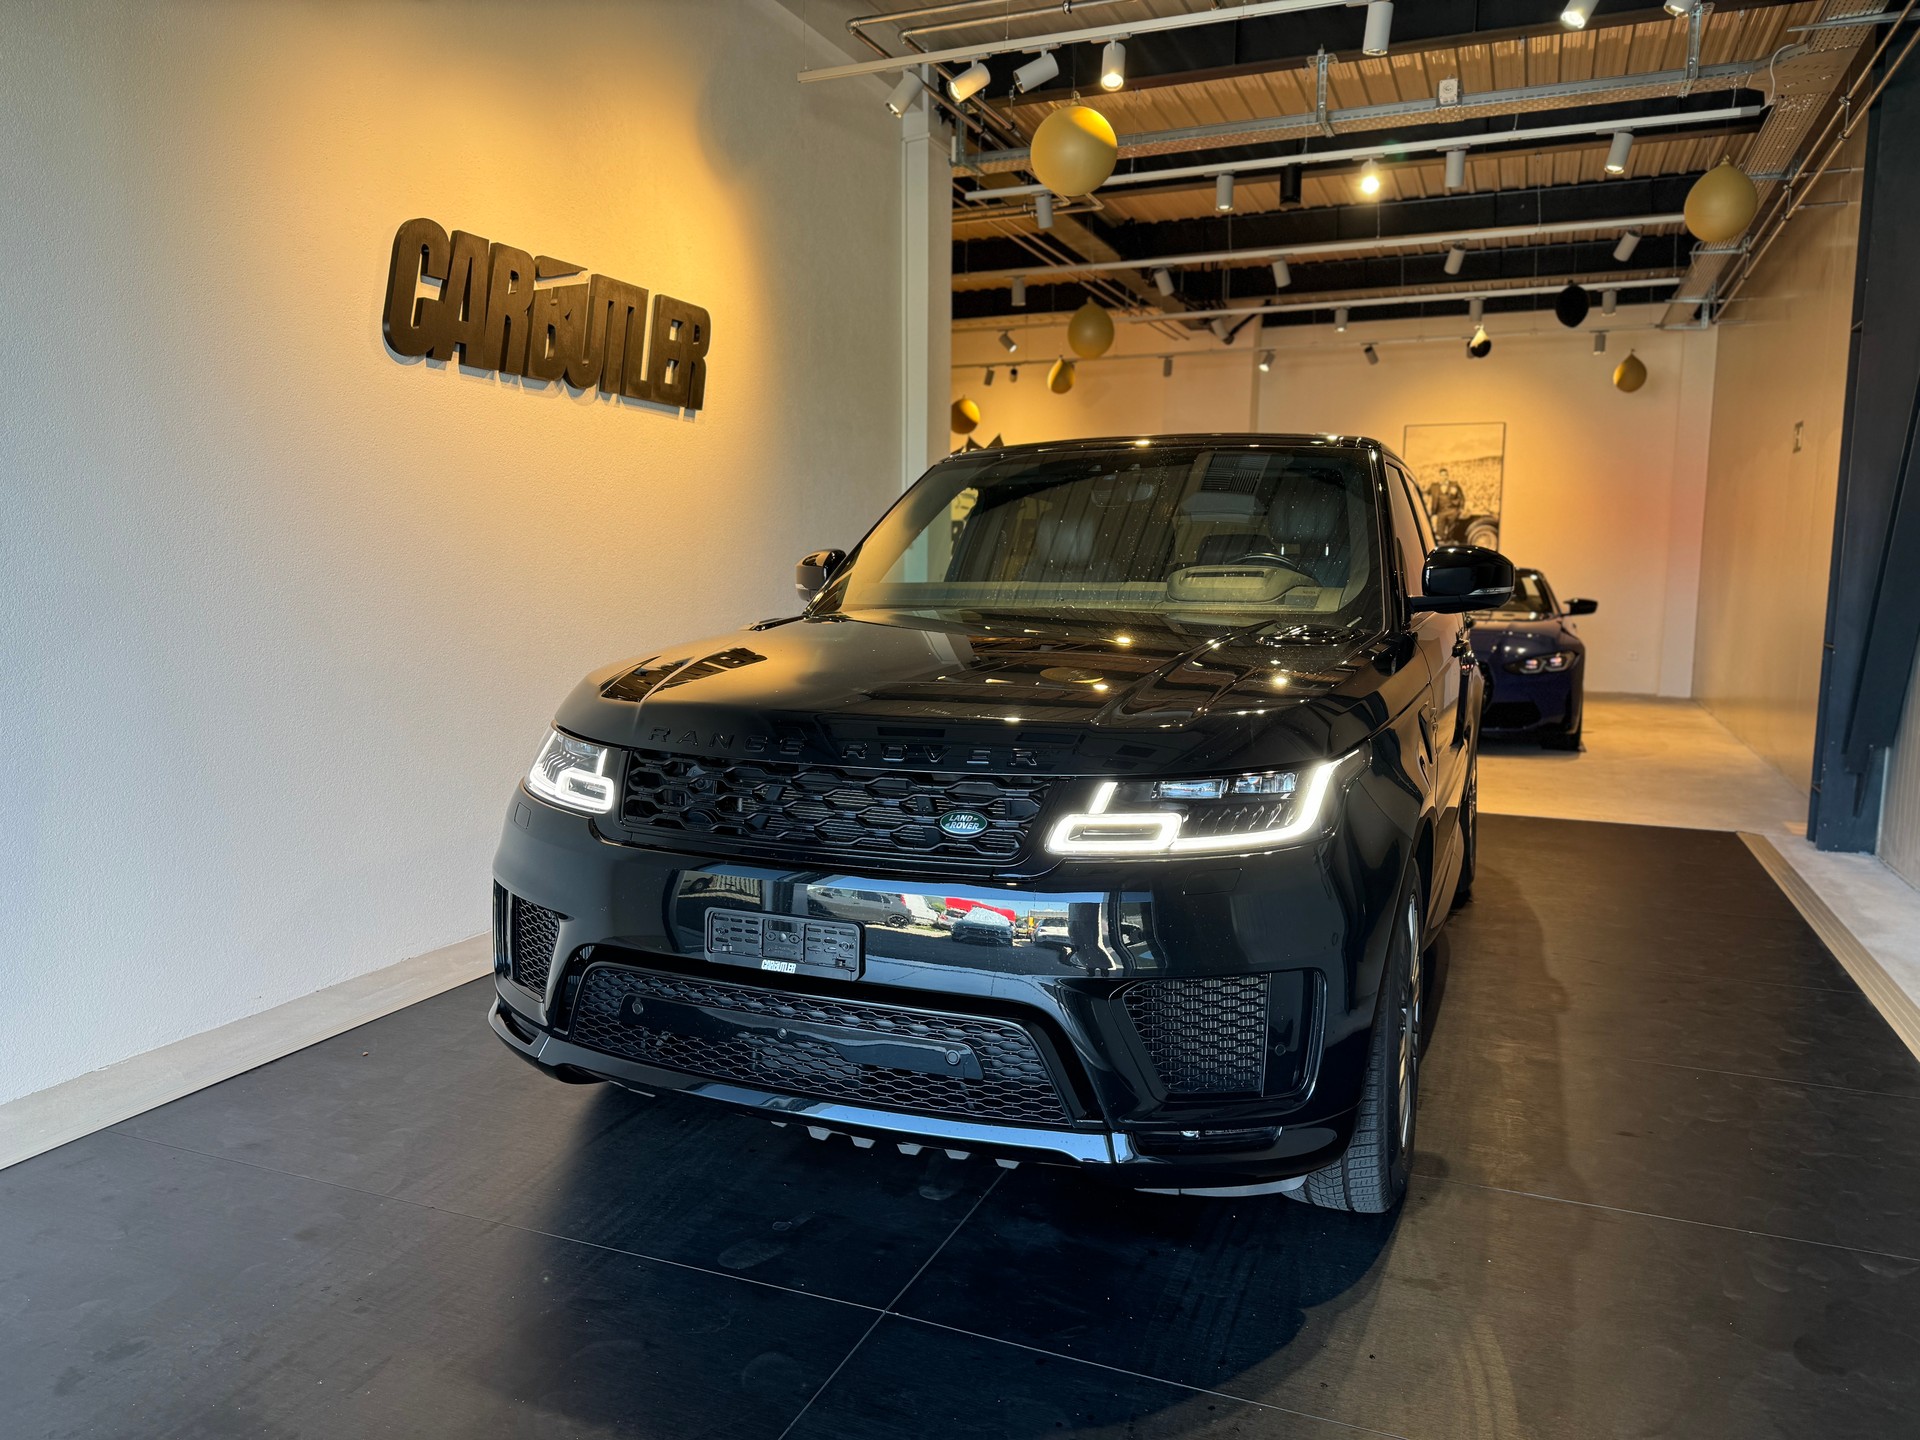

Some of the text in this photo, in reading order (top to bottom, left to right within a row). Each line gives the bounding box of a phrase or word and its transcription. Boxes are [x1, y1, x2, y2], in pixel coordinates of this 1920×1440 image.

[382, 217, 711, 412] CARBUTLER
[648, 726, 1038, 767] RANGE ROVER
[949, 814, 973, 822] LAND
[949, 821, 980, 830] ROVER
